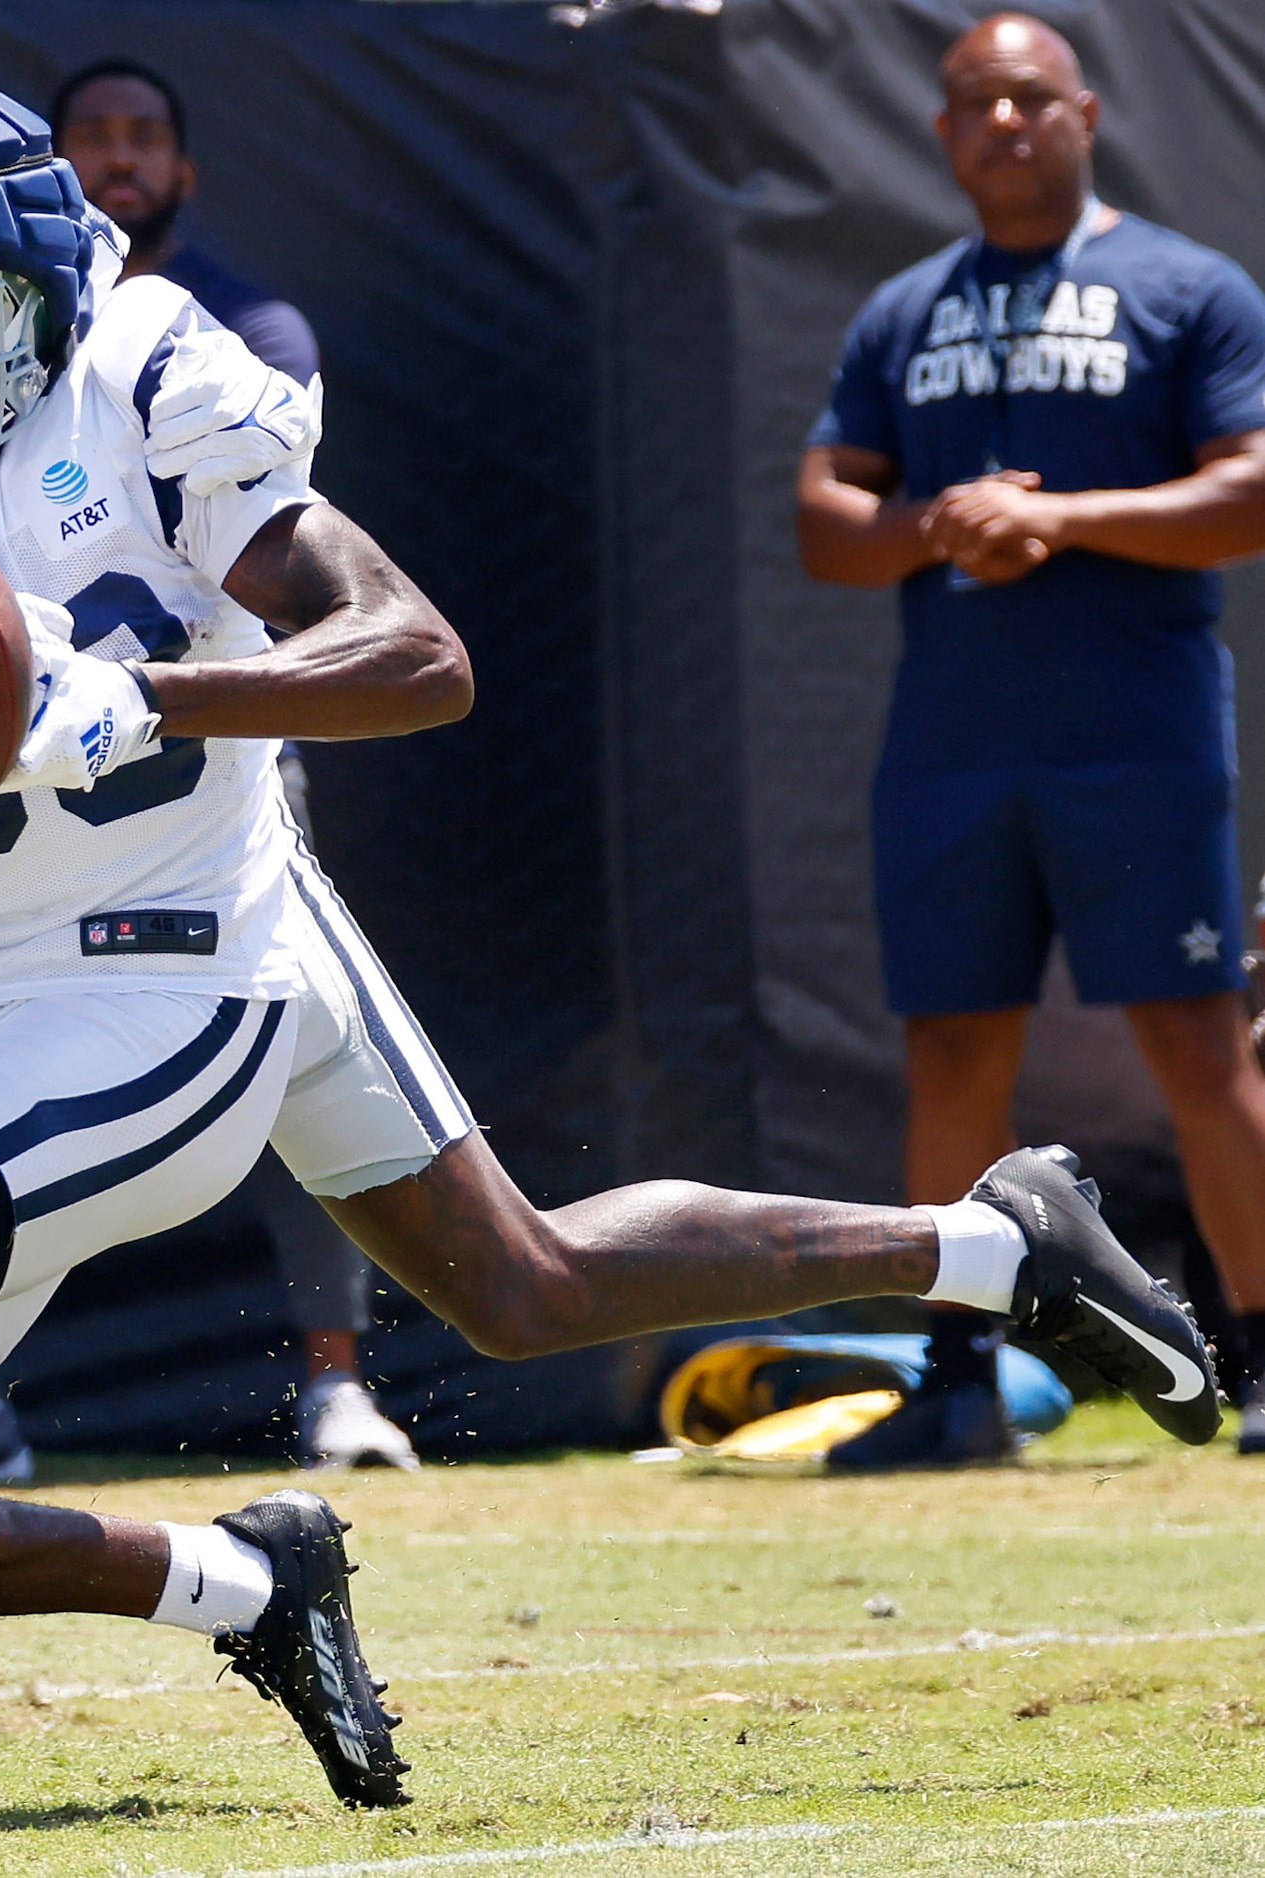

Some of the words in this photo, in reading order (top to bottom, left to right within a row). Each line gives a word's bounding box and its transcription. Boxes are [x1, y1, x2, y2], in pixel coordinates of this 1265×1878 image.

[928, 280, 1119, 347] DALAS
[904, 334, 1129, 407] COWBOYS
[60, 497, 110, 541] AT&T
[90, 707, 113, 778] adidas
